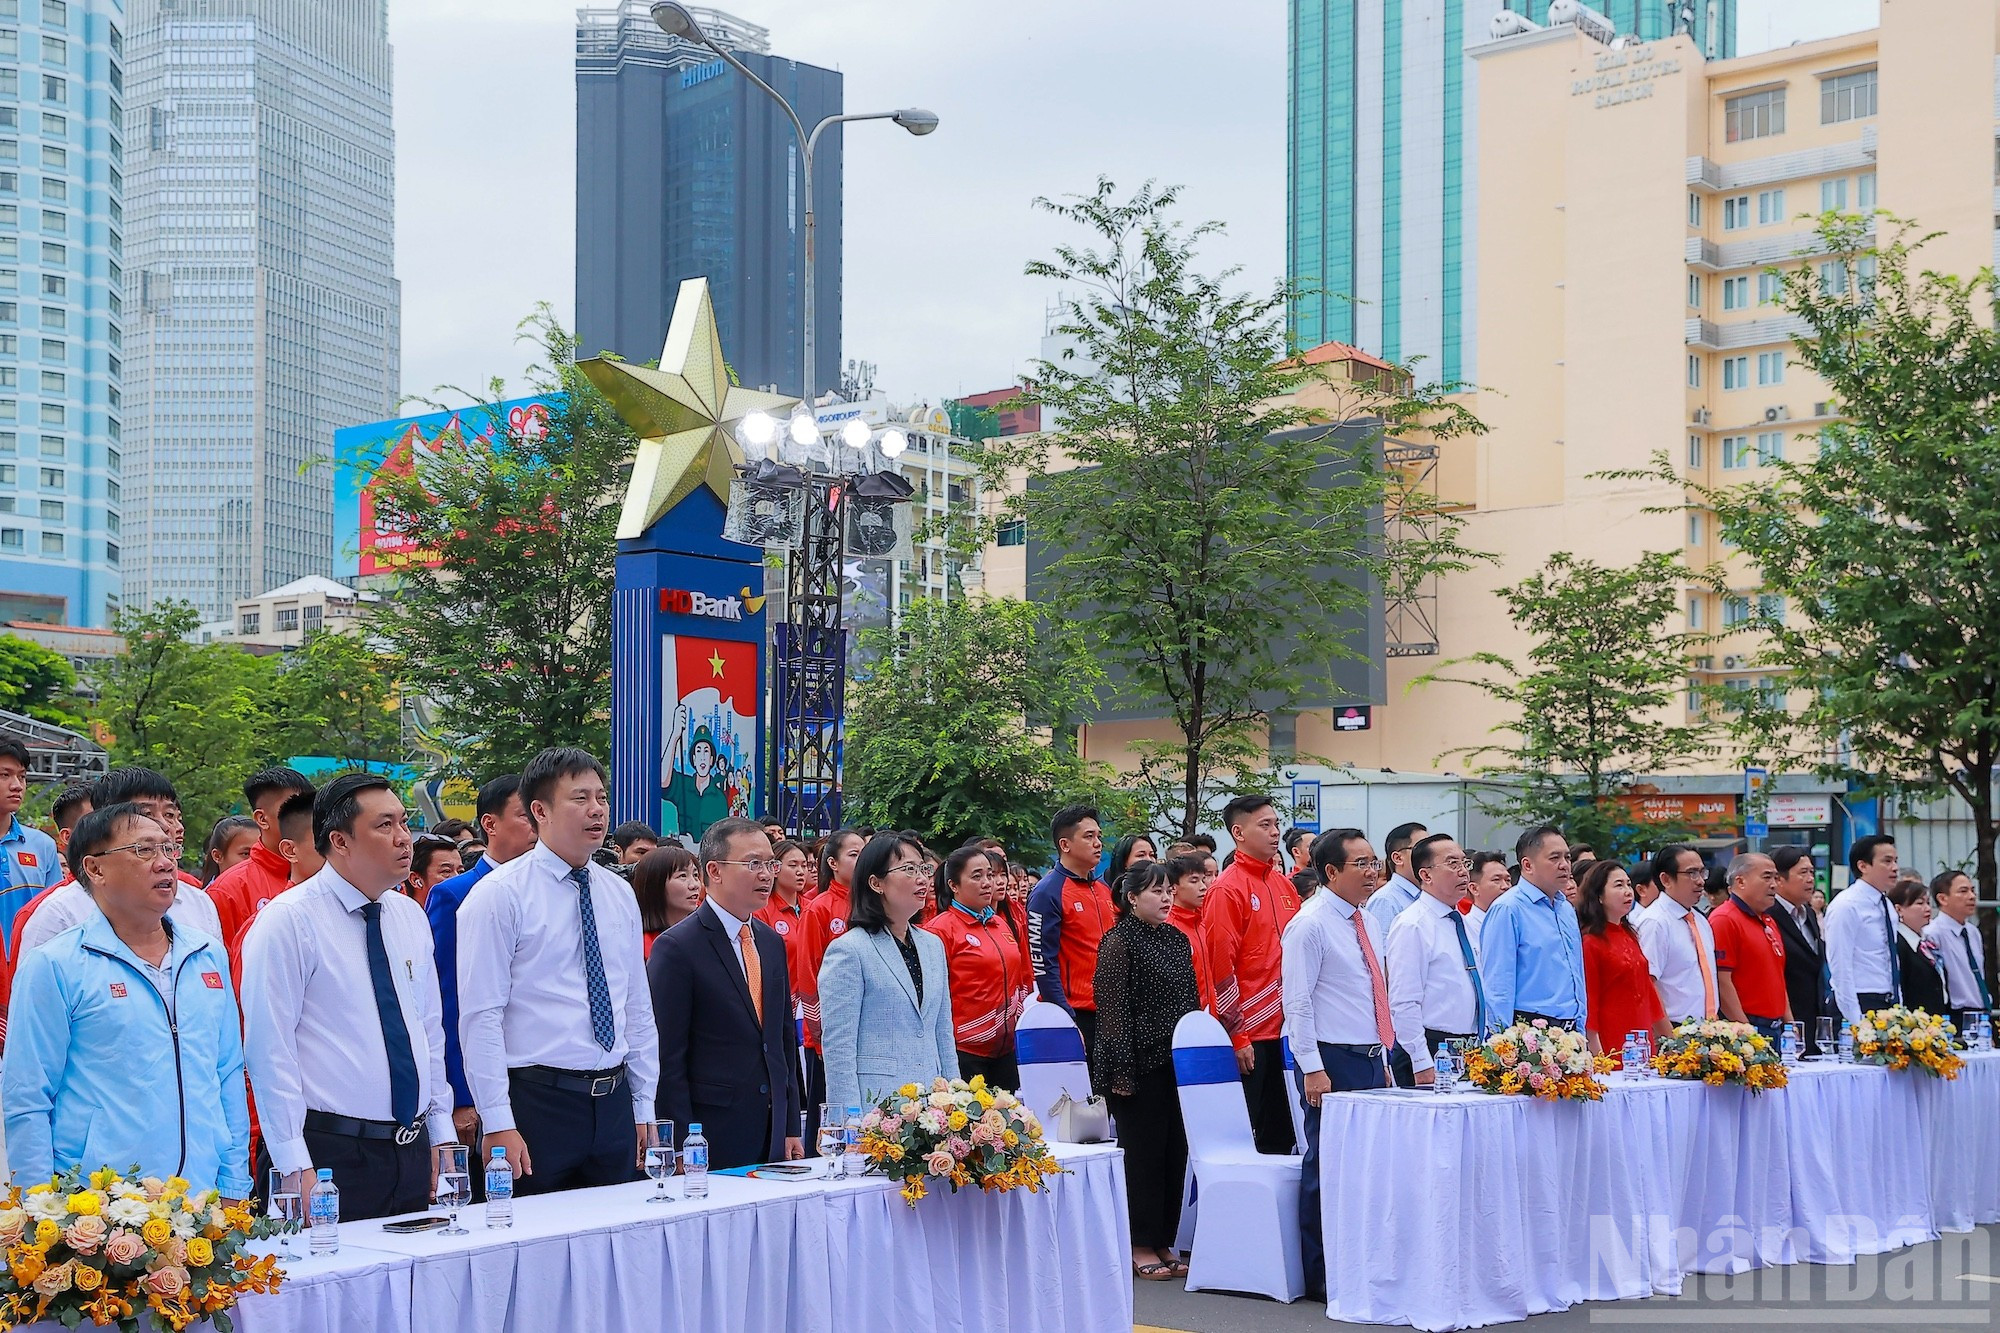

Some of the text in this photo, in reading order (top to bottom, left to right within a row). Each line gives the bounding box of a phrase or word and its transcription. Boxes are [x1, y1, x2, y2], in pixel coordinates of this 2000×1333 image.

[682, 60, 724, 89] Hilton
[1571, 60, 1680, 96] ROYAL HOTEL
[1595, 83, 1654, 109] SAIGON
[816, 409, 861, 424] AIGONTOURIST
[928, 423, 949, 435] OSCAR
[660, 587, 742, 620] HDBank
[1028, 910, 1047, 977] VIETNAM
